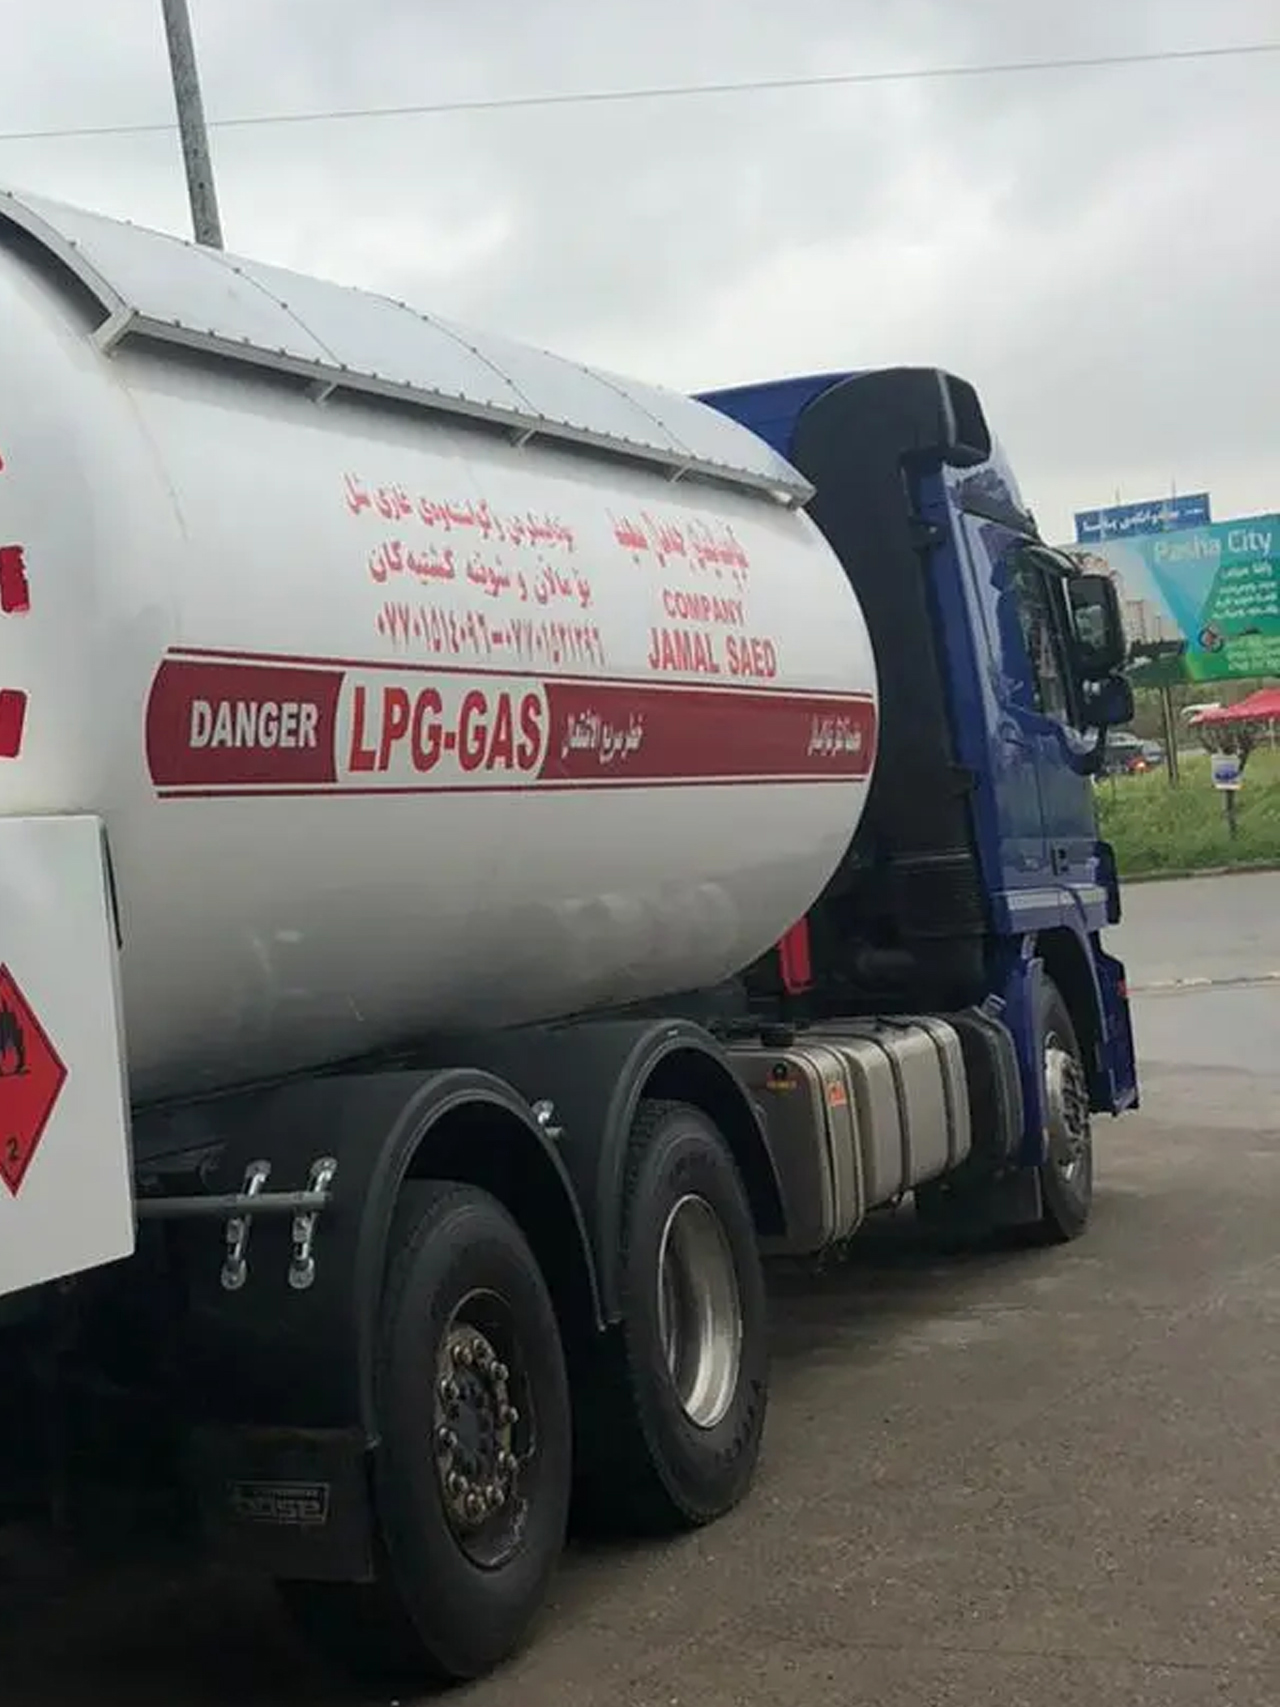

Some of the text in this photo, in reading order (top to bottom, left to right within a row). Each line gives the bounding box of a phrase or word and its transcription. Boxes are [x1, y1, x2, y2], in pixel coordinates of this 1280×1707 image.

[1227, 528, 1271, 556] City
[662, 588, 744, 625] COMPANY
[648, 628, 777, 678] JAMAL SAED
[189, 700, 318, 749] DANGER
[348, 686, 542, 773] LPG-GAS
[5, 1136, 20, 1161] 2
